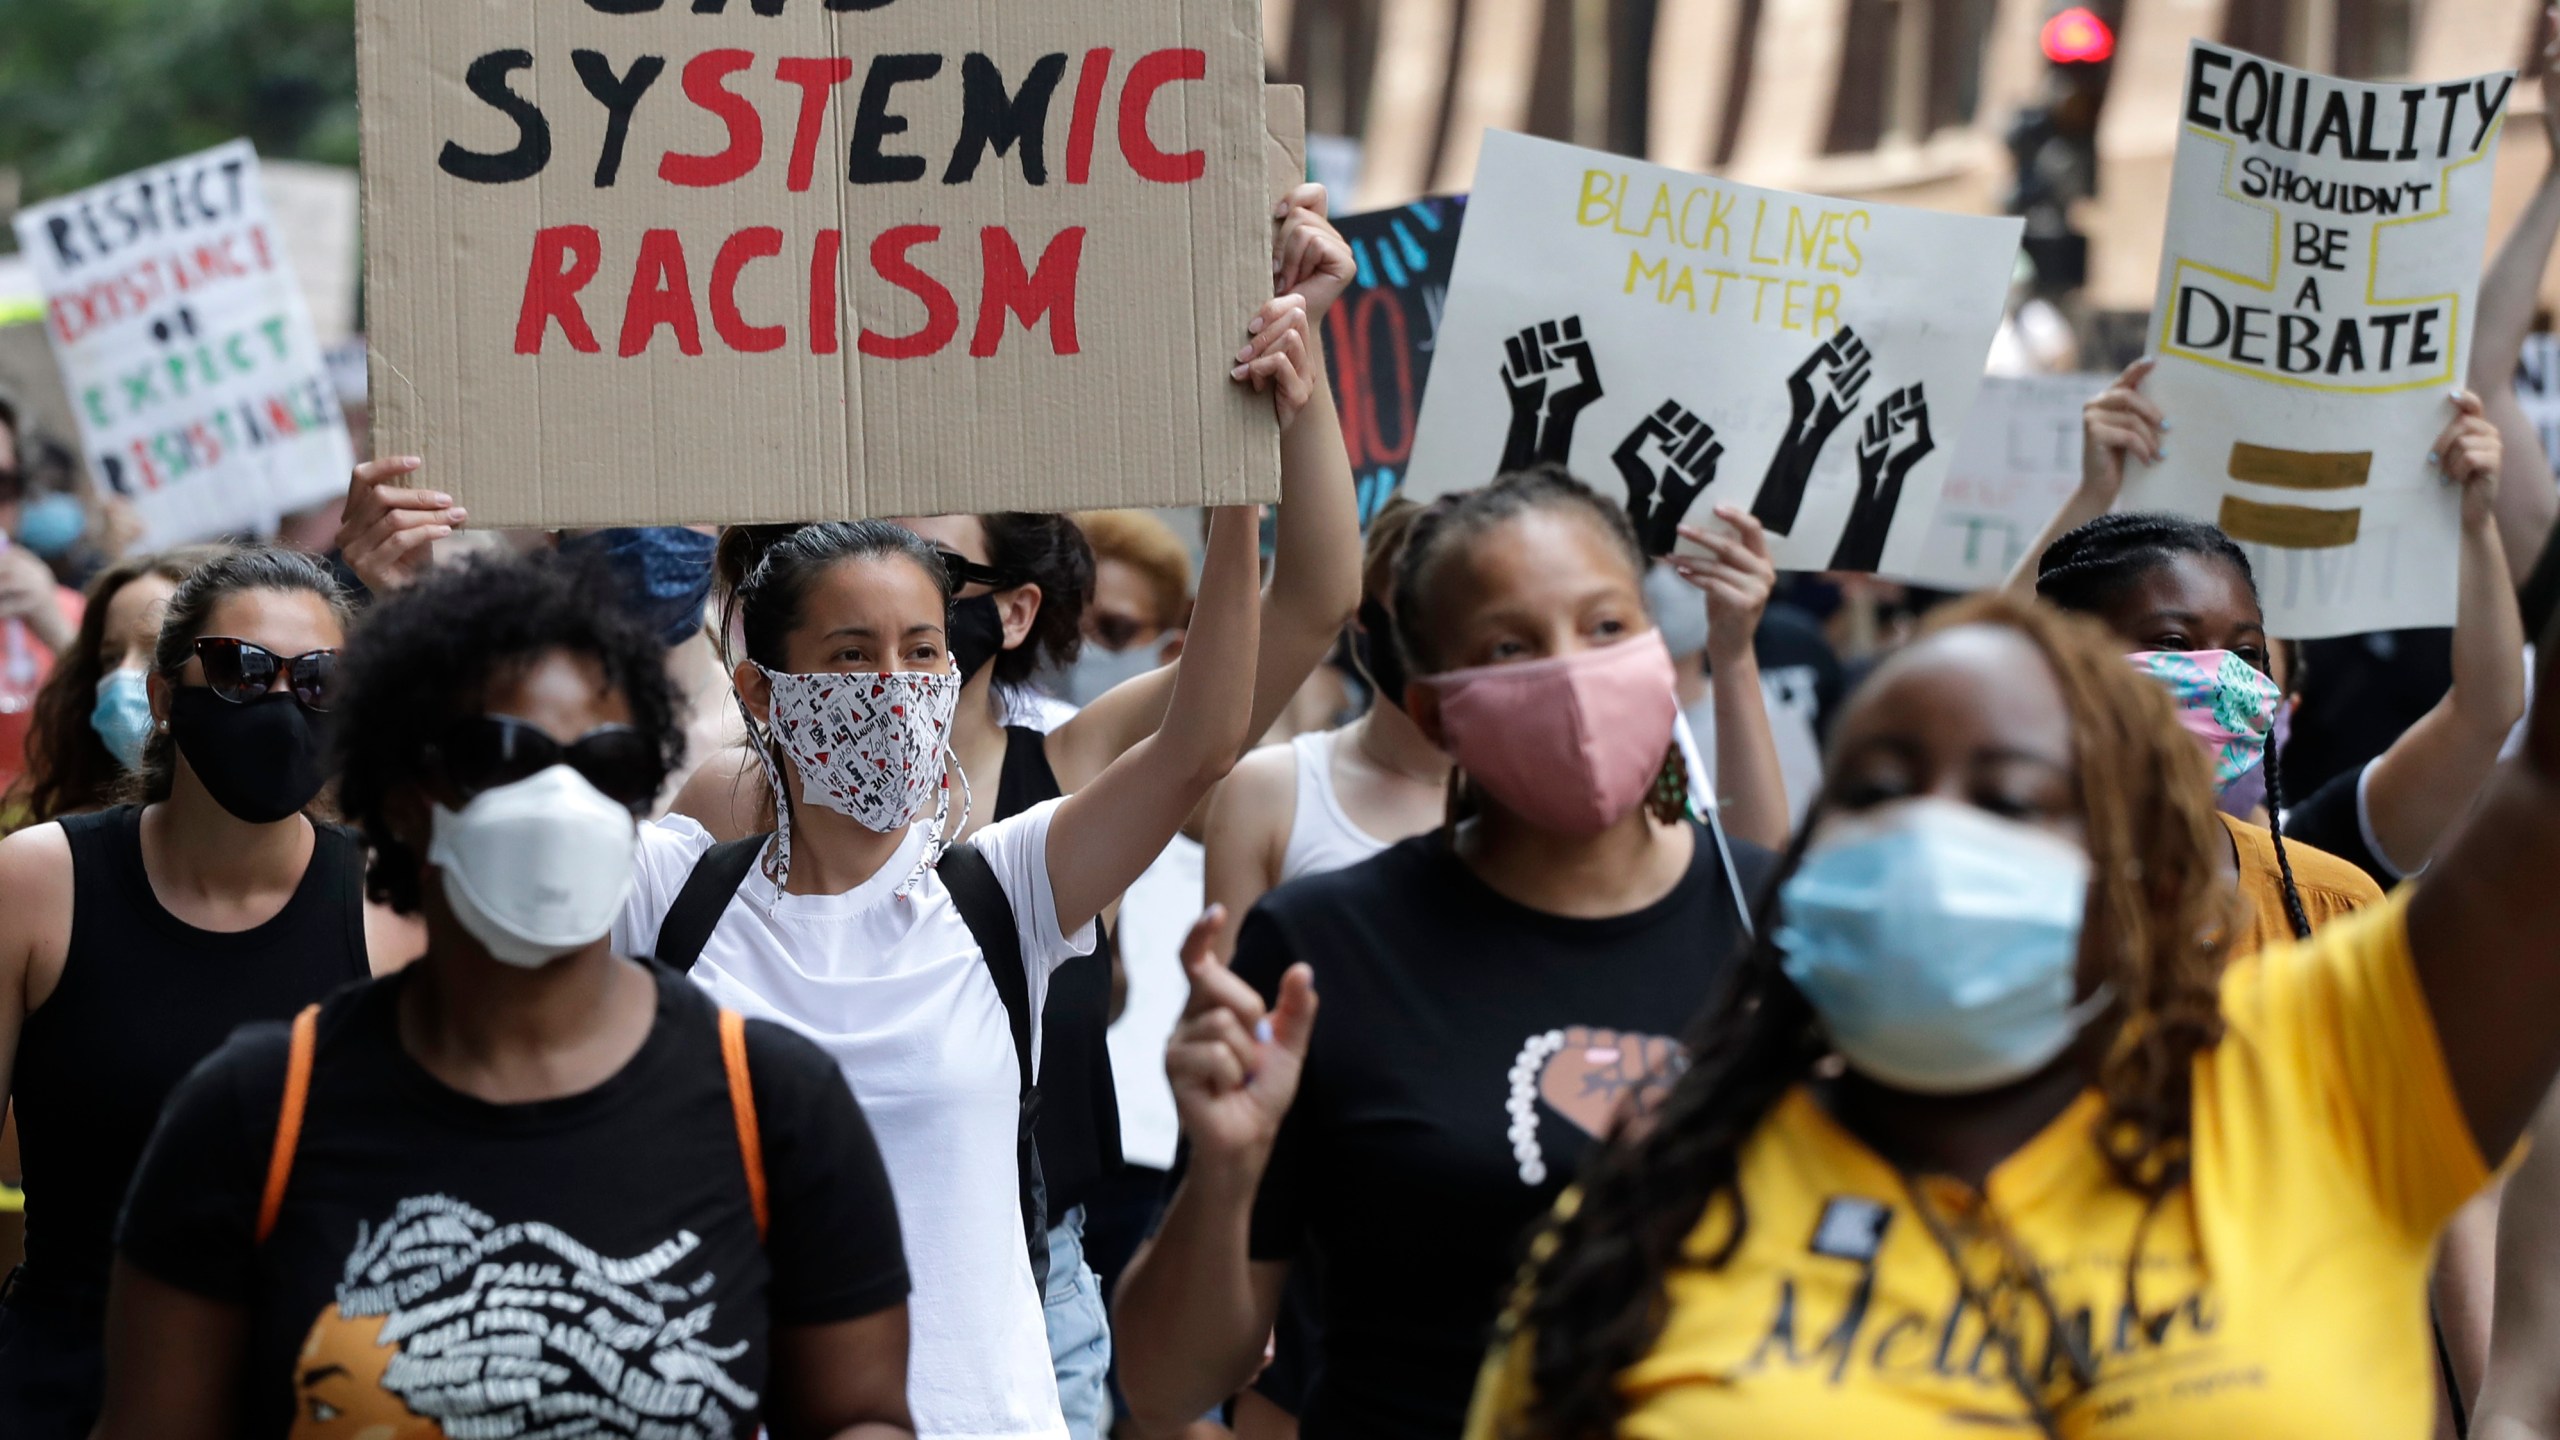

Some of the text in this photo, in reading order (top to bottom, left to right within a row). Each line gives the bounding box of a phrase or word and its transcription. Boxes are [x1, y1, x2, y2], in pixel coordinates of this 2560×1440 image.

[438, 46, 1206, 192] SYSTEMIC
[2186, 47, 2517, 162] EQUALITY
[1577, 169, 1870, 276] BLACK LIVES
[2240, 157, 2431, 215] SHOULDN'T
[2293, 222, 2348, 271] BE
[513, 225, 1087, 360] RACISM
[1623, 250, 1842, 338] MATTER
[2175, 286, 2440, 376] DEBATE
[2294, 276, 2323, 313] A
[472, 1261, 566, 1290] PAUL
